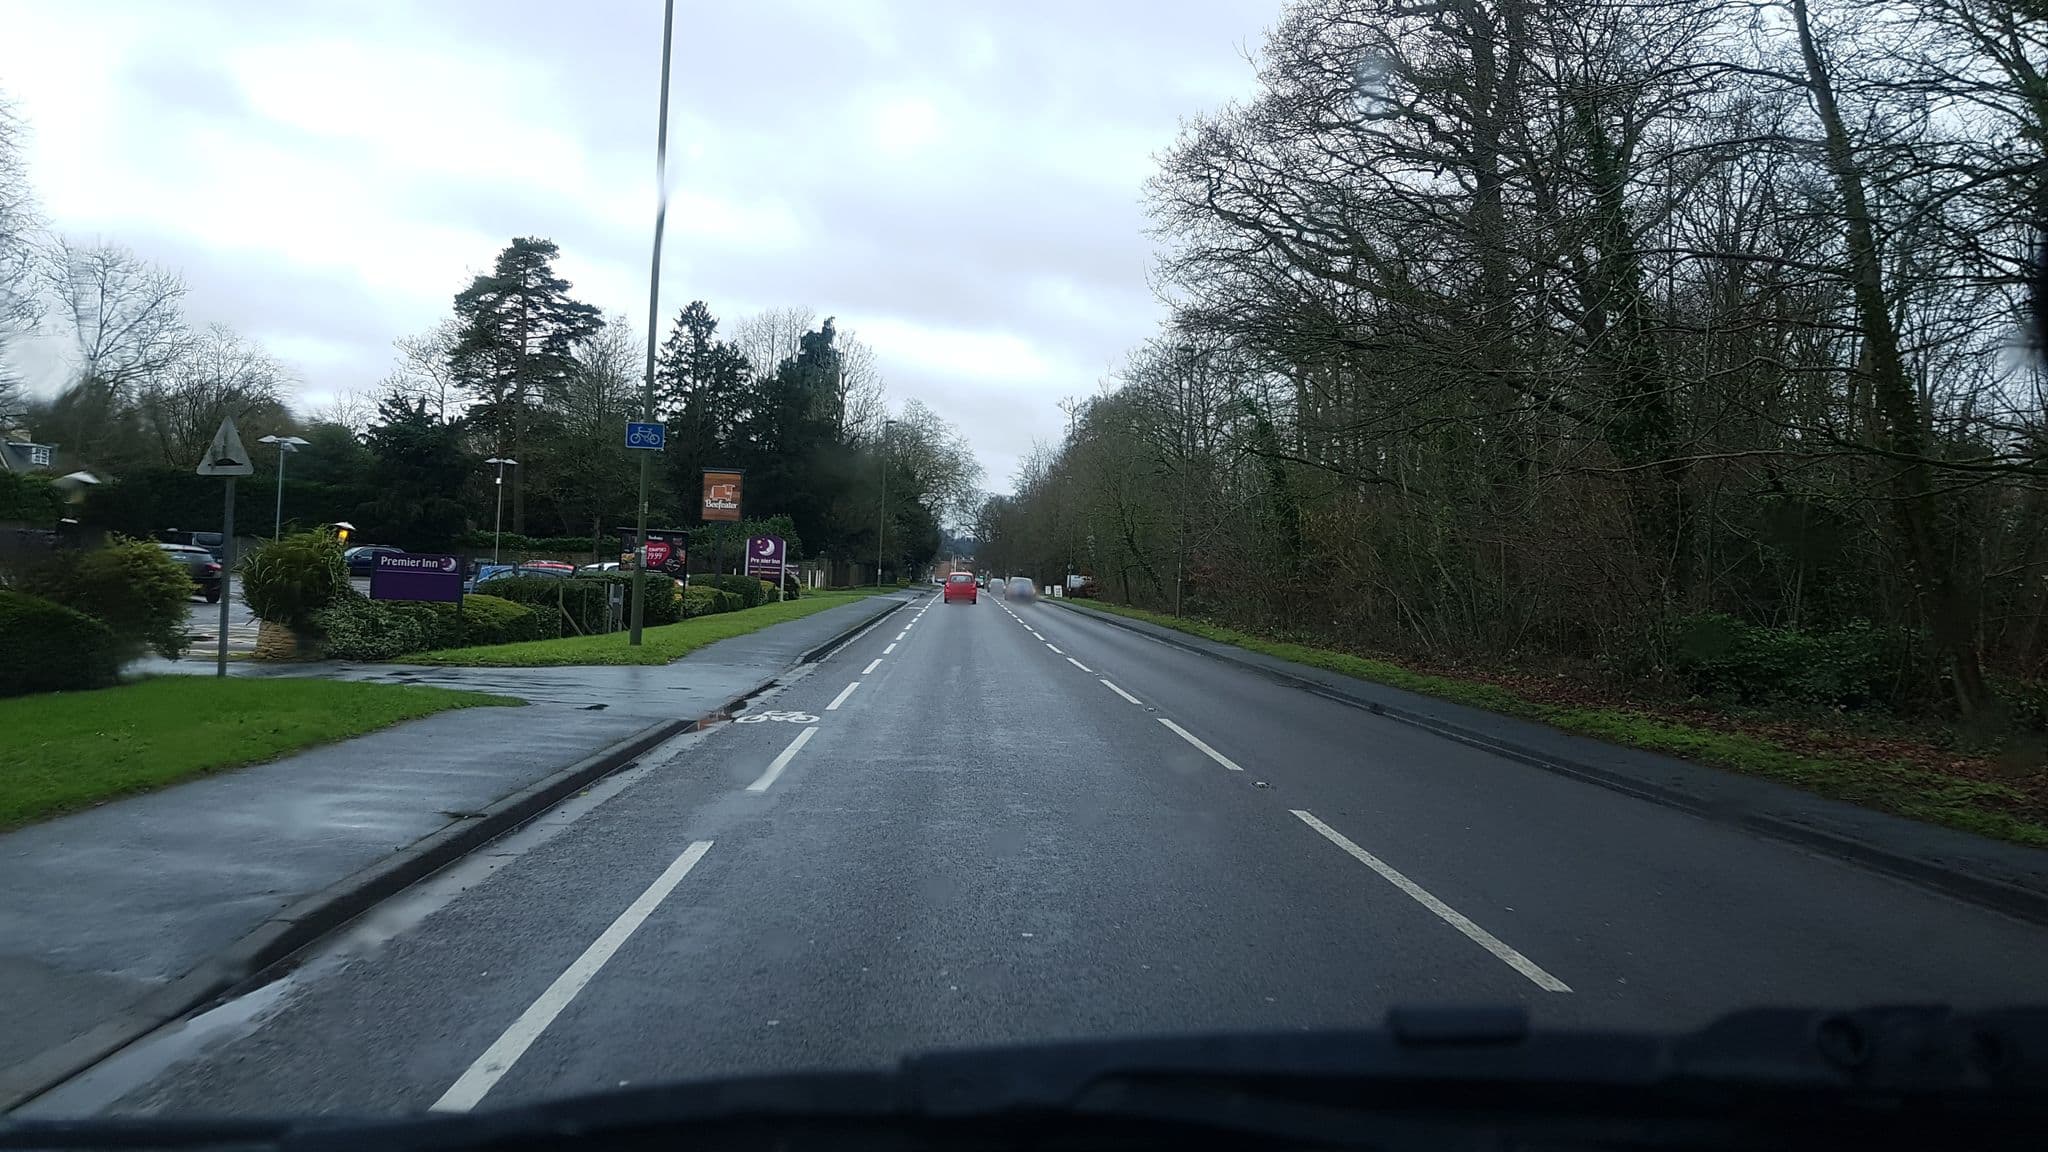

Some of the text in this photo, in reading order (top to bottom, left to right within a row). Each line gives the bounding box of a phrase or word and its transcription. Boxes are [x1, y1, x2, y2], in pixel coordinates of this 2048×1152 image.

[705, 499, 738, 510] Beefeater
[381, 556, 438, 568] Premier Inn
